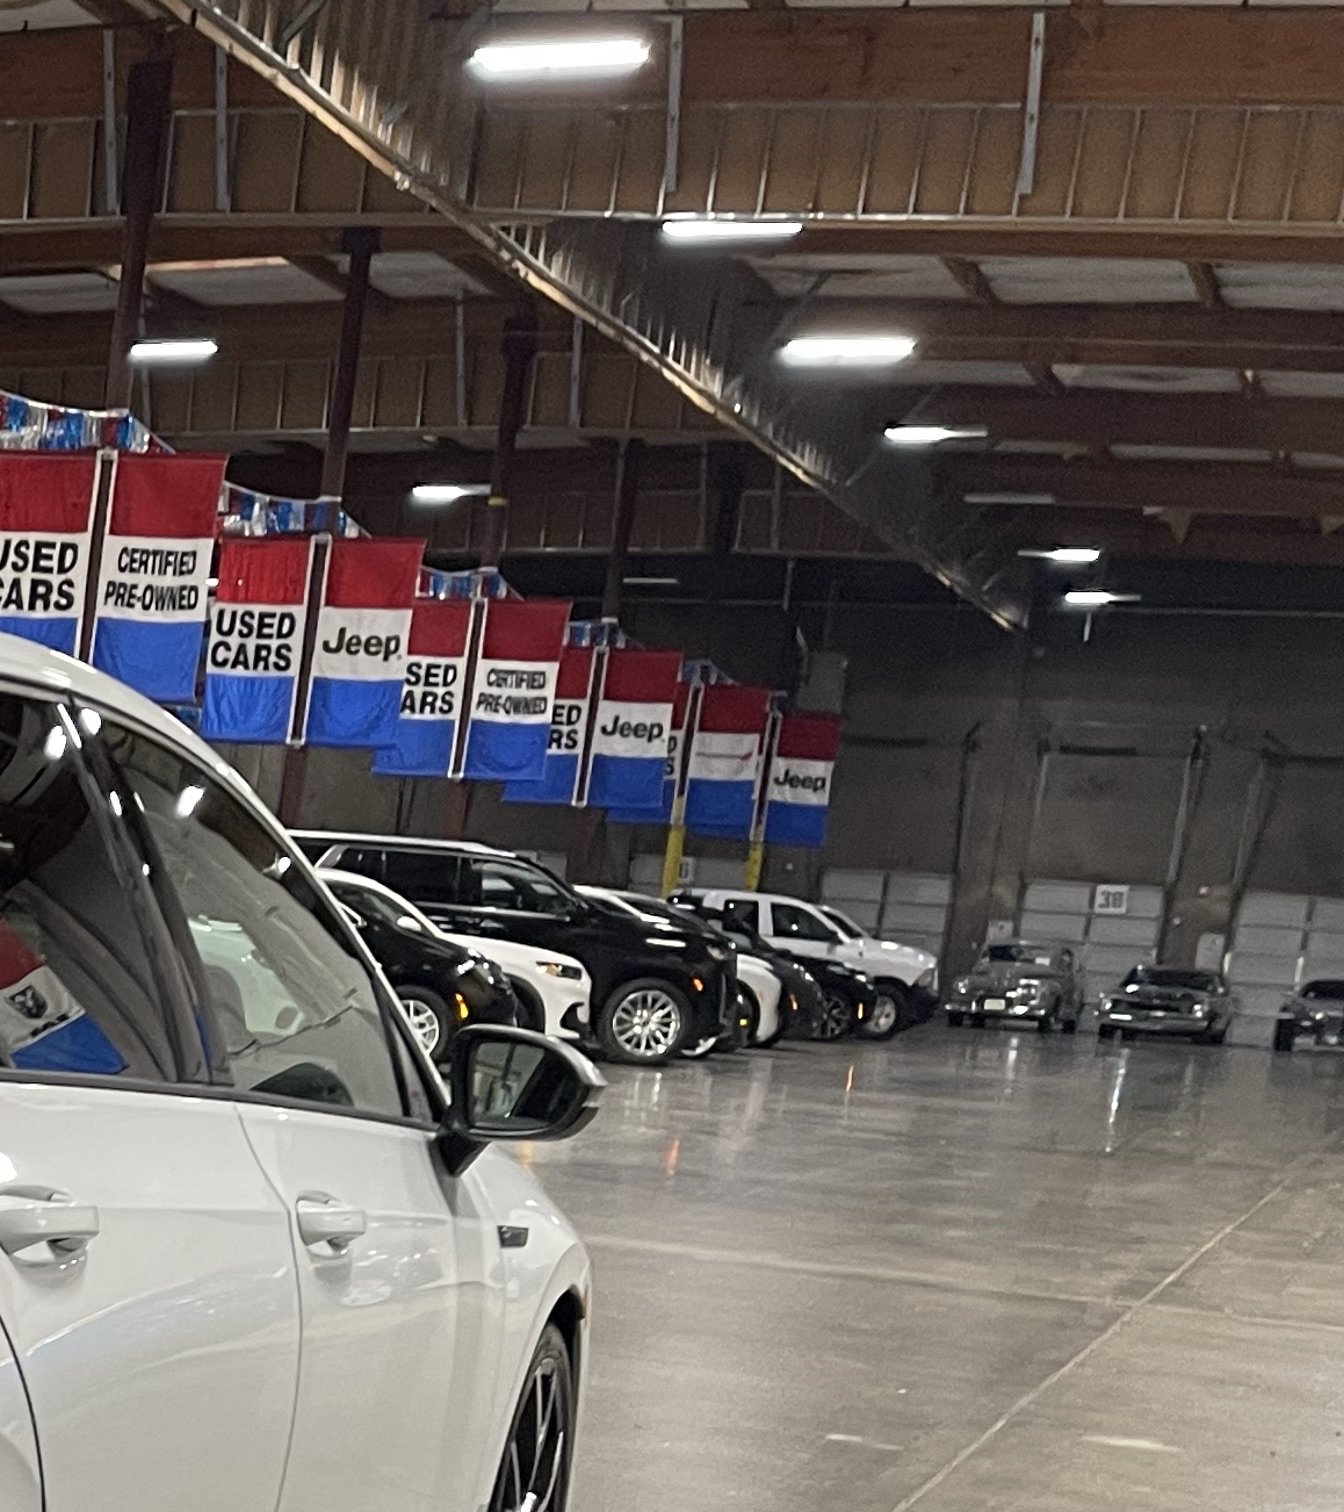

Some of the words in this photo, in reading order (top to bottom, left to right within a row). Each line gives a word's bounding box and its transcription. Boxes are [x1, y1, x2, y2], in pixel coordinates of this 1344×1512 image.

[117, 547, 197, 576] CERTIFIED
[103, 580, 199, 611] PRE-OWNED
[216, 608, 296, 639] USED
[211, 641, 292, 672] CARS
[322, 627, 401, 662] Jeep
[404, 662, 458, 687] SED
[486, 668, 547, 690] CERTIFIED
[400, 690, 455, 714] ARS
[476, 692, 548, 715] PRE-OWNED
[551, 704, 582, 726] ED
[547, 728, 578, 750] RS
[600, 714, 664, 743] Jeep
[773, 768, 826, 793] Jeep
